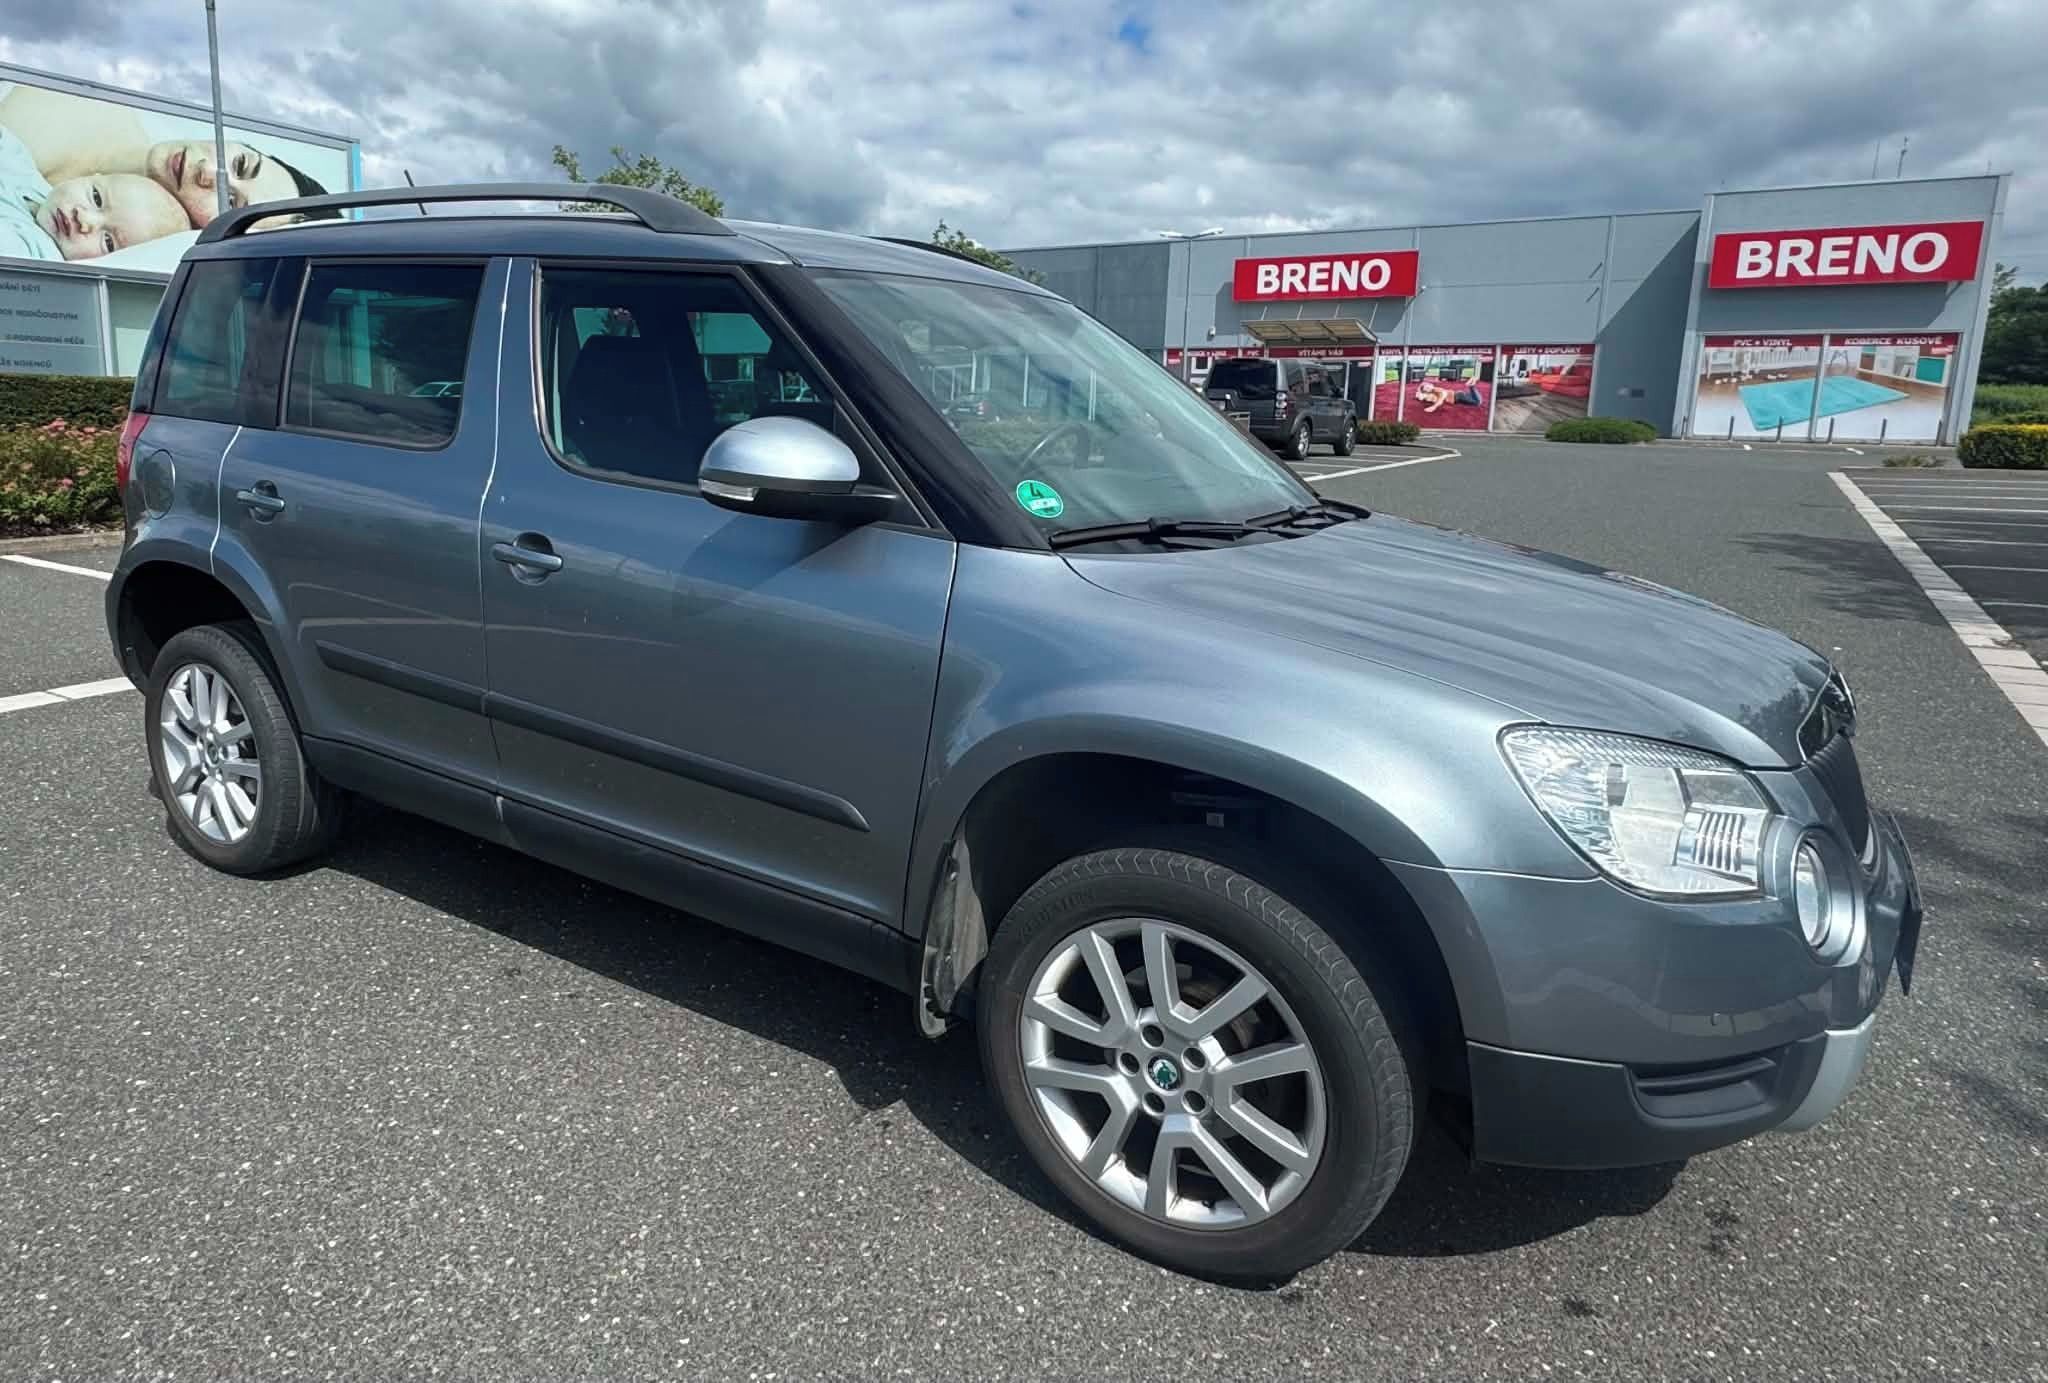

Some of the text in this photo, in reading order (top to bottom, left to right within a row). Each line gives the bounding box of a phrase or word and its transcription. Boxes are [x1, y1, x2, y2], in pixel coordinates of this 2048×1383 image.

[1735, 233, 1949, 279] BRENO
[1256, 258, 1391, 294] BRENO
[1762, 338, 1793, 346] VINYL
[1844, 337, 1892, 345] KOBERCE
[1029, 482, 1045, 498] 4
